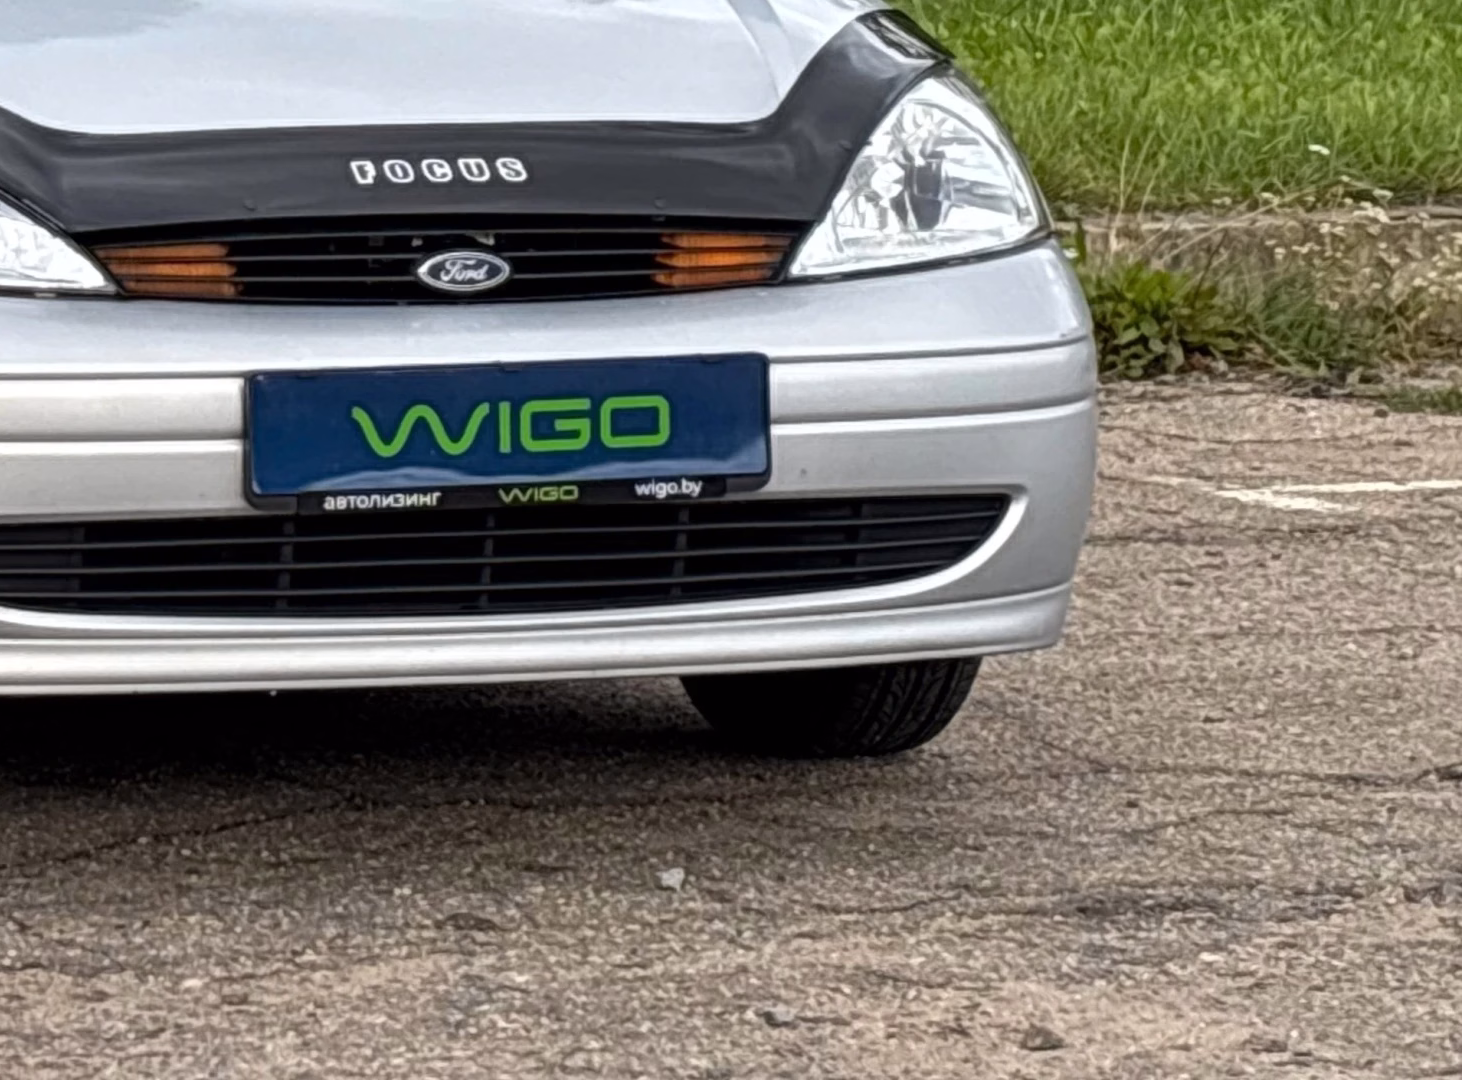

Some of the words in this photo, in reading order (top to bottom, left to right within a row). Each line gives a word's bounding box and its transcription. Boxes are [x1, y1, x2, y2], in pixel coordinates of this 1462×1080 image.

[349, 157, 528, 184] FOCUS
[440, 259, 489, 281] Ford
[351, 395, 671, 457] WIGO
[498, 485, 579, 503] WIGO
[635, 478, 703, 498] wigo.by
[323, 491, 442, 511] автолизинг
